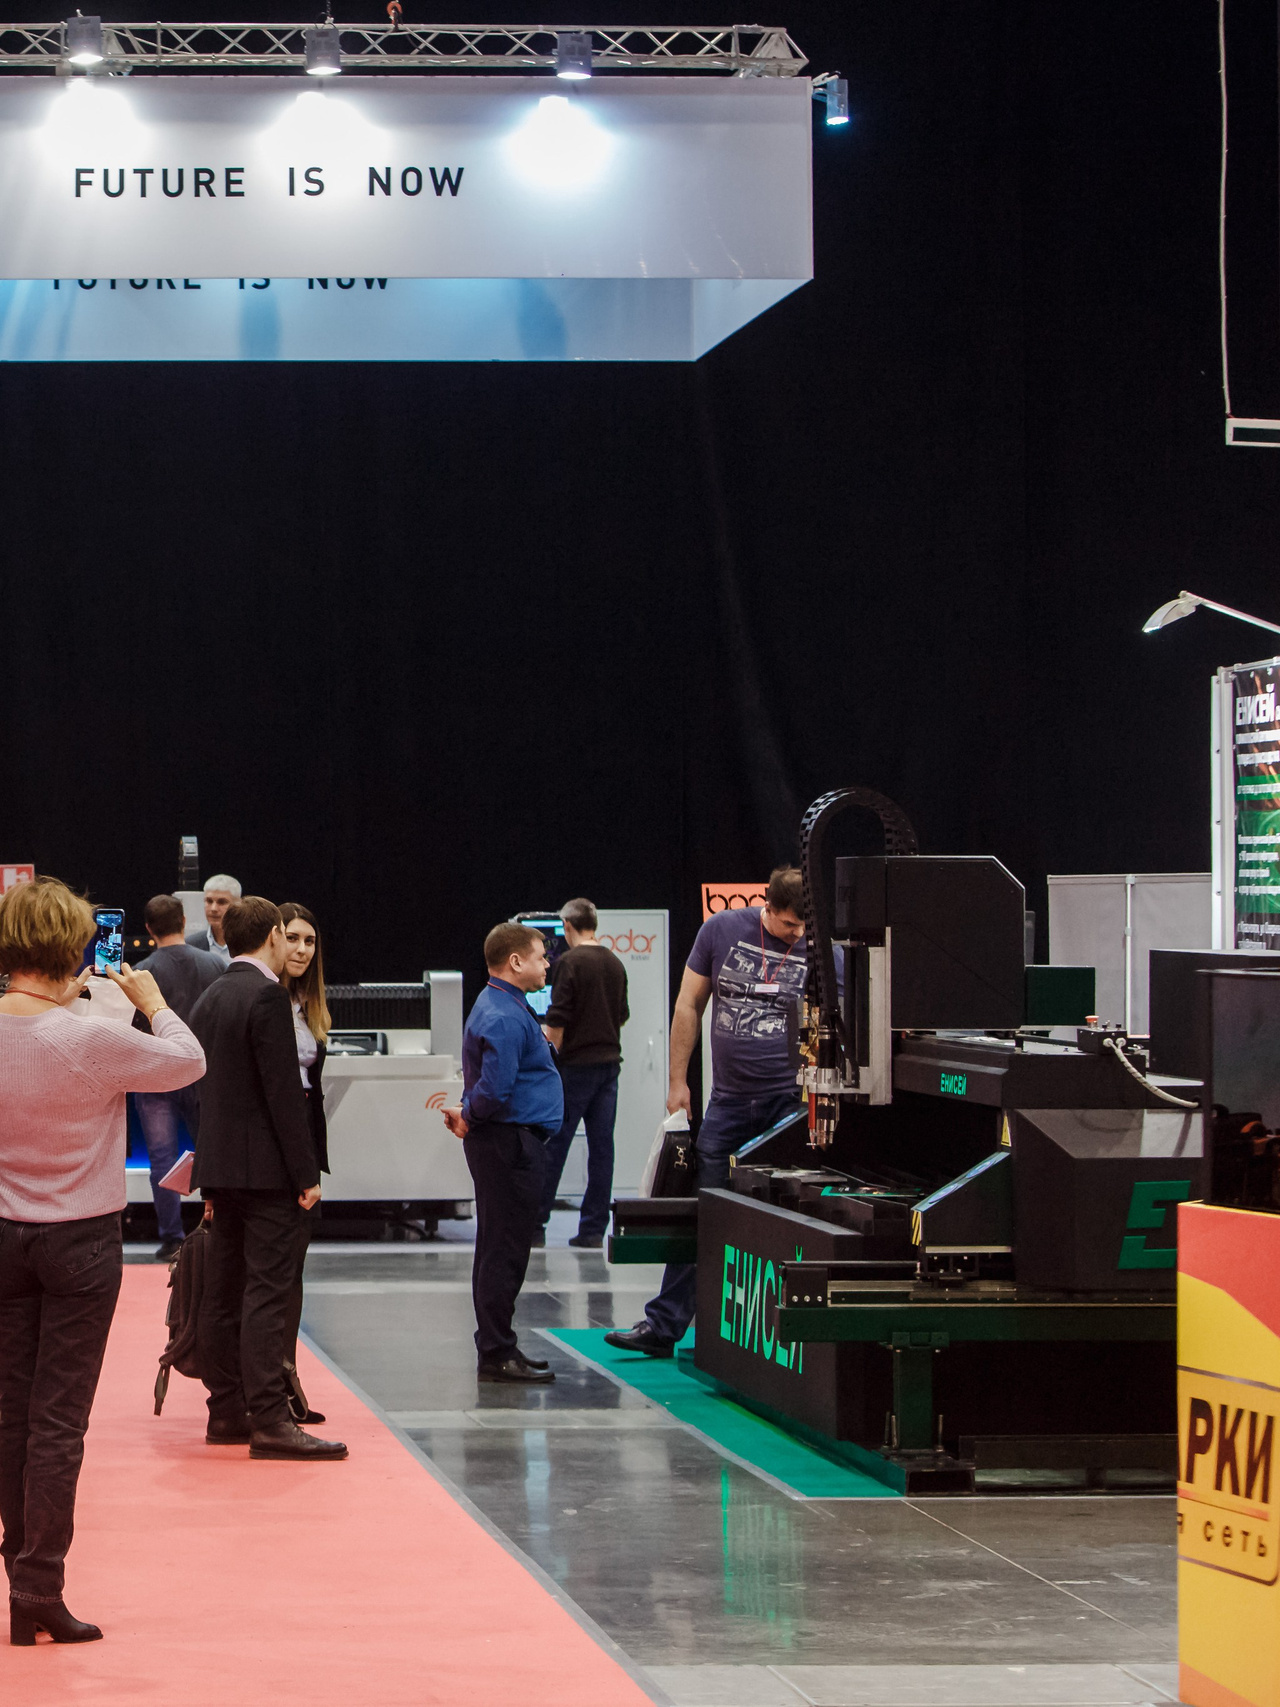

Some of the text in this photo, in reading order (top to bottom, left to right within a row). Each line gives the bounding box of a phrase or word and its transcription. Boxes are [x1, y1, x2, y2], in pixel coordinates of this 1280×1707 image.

[75, 166, 465, 197] FUTURE IS NOW
[940, 1072, 968, 1096] ЕНИСЕЙ
[1177, 1396, 1275, 1505] РКИ
[1203, 1520, 1268, 1558] сеть
